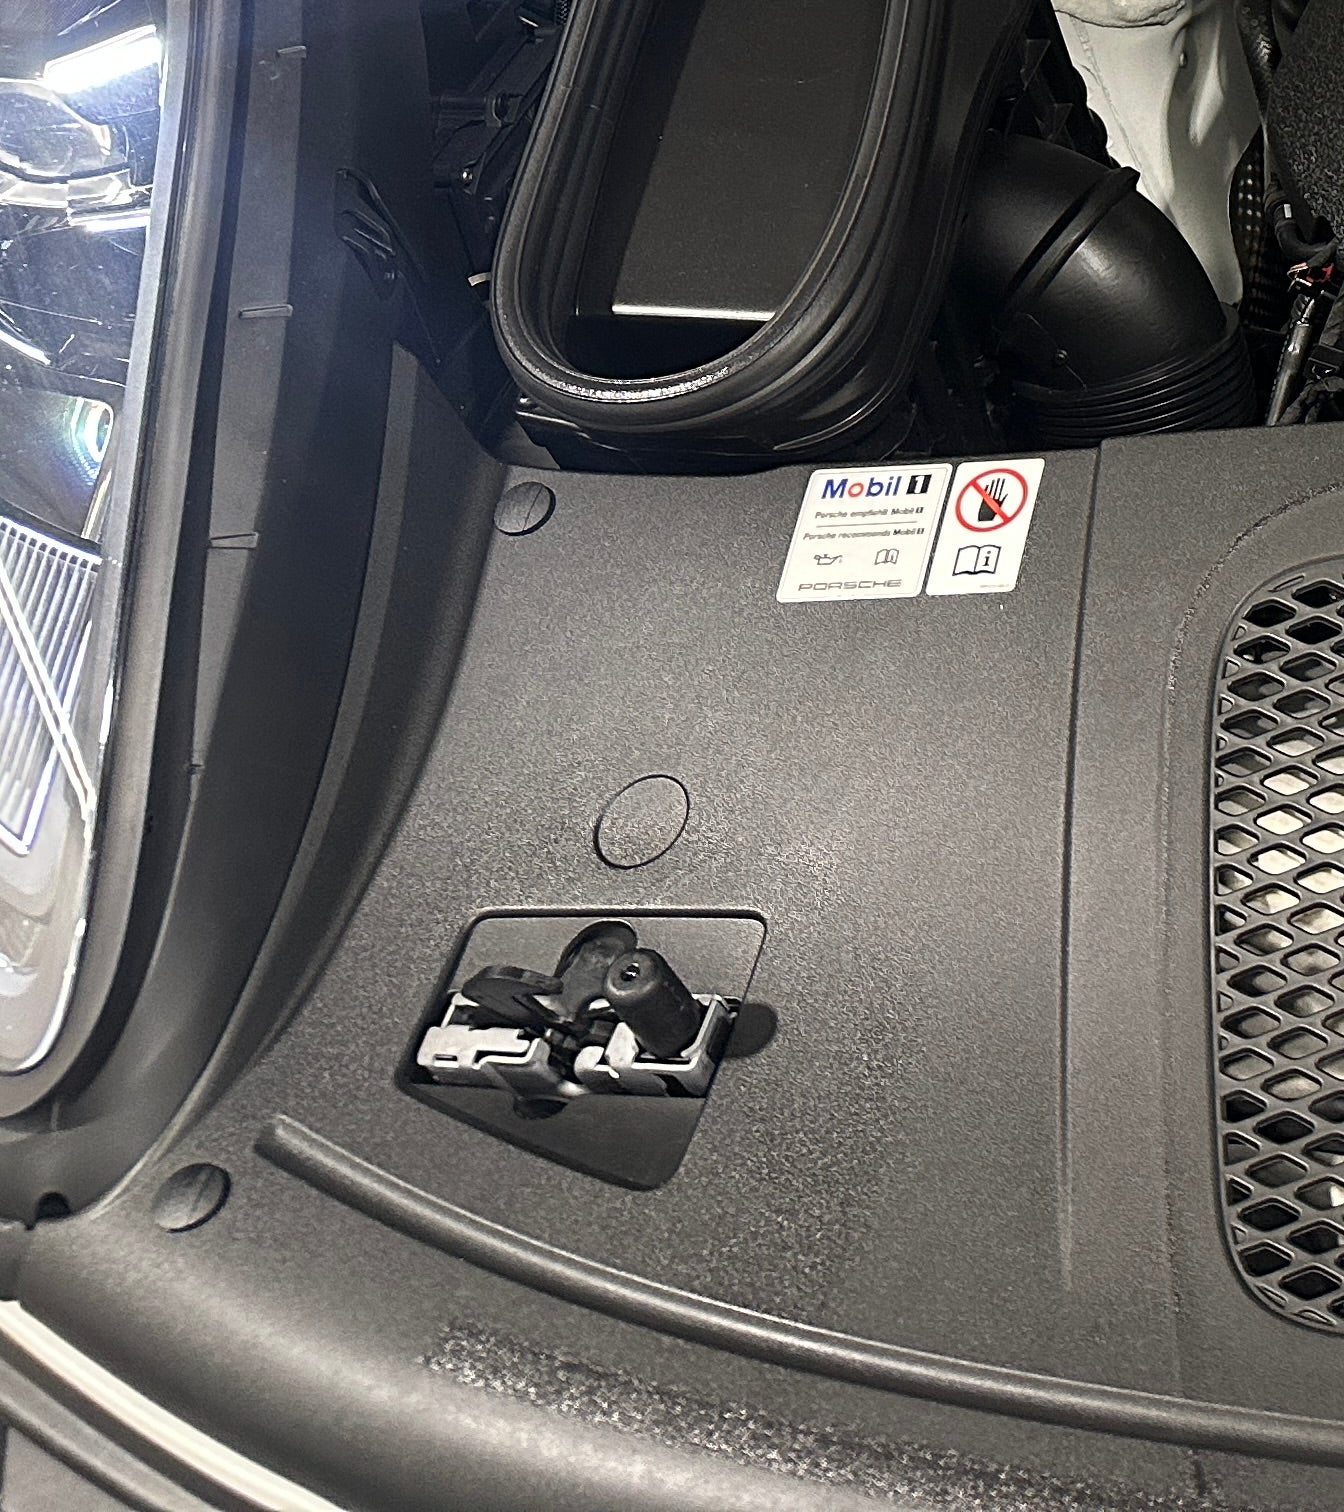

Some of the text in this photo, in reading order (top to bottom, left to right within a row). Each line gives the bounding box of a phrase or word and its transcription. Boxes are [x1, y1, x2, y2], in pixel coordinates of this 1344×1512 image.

[821, 475, 902, 499] Mobil
[814, 510, 848, 520] Porsche
[891, 507, 915, 515] Mobil
[802, 532, 836, 540] Porsche
[893, 528, 916, 537] Mobil
[797, 579, 902, 591] PORSCHE
